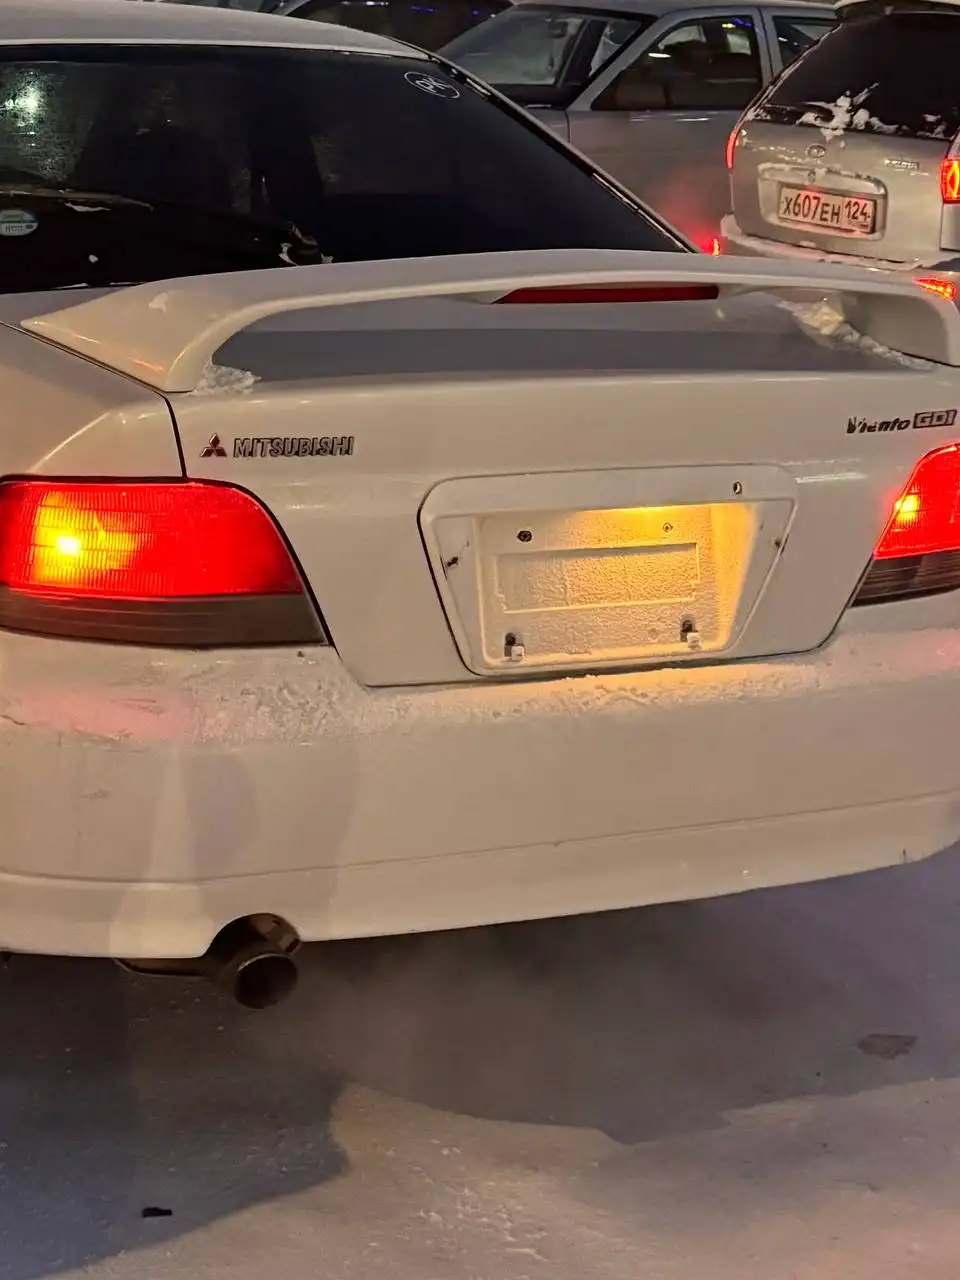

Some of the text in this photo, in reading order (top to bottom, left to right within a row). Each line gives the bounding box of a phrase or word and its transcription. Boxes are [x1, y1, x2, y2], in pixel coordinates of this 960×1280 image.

[844, 200, 869, 222] 124
[913, 410, 957, 429] GDI
[232, 436, 355, 458] MITSUBISHI
